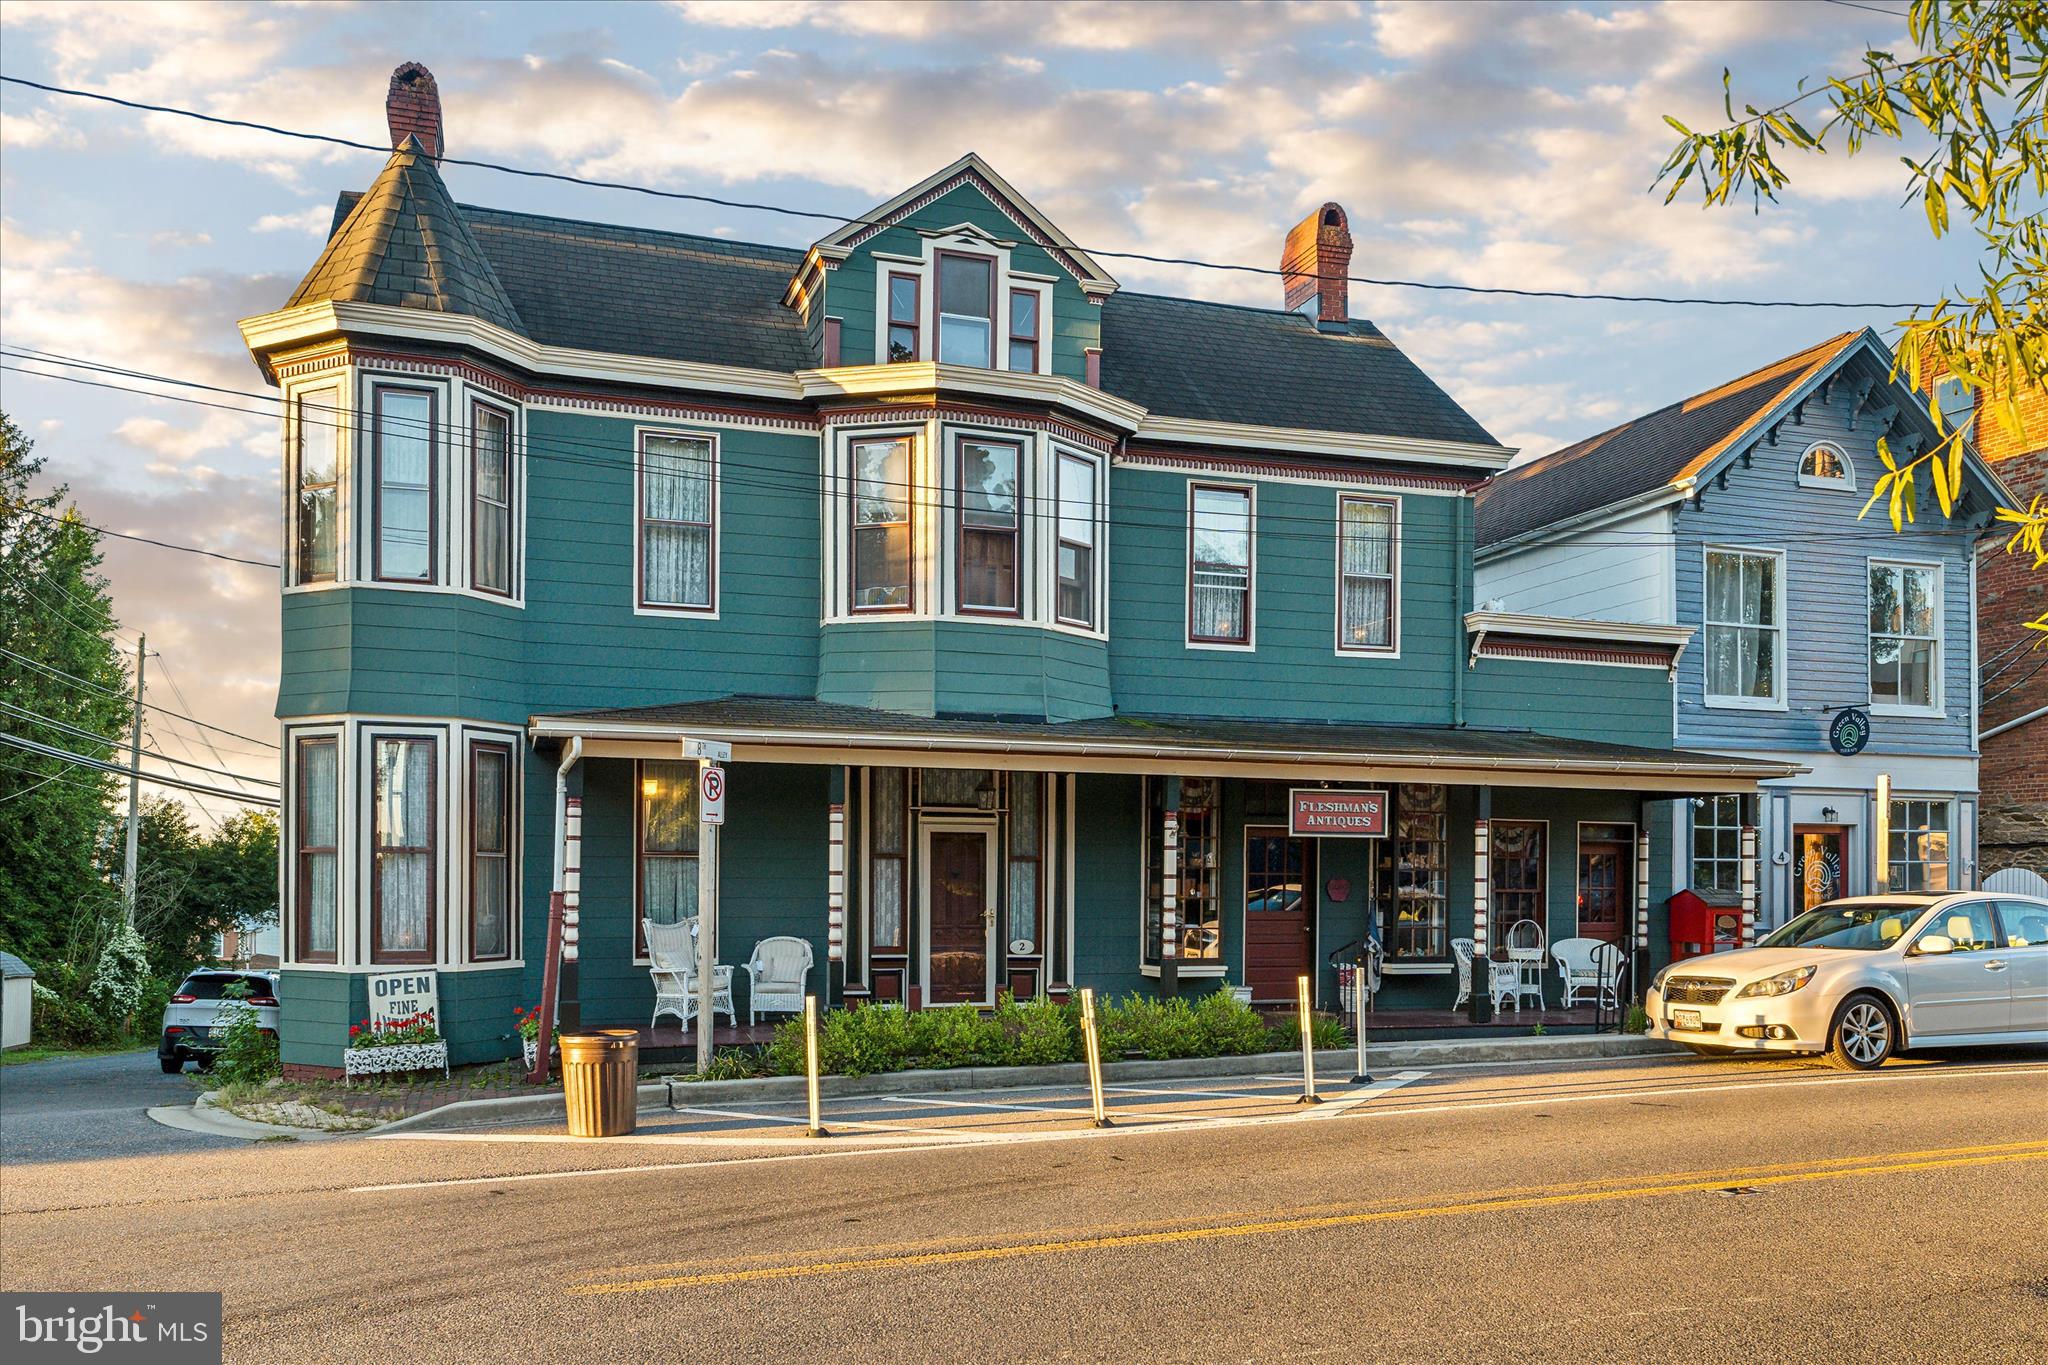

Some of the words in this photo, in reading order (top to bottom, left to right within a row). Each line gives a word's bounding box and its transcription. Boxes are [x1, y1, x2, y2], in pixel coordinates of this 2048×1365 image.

[1832, 716, 1850, 738] Green
[1851, 713, 1866, 736] Valley
[1299, 800, 1379, 814] FLESHMAN'S
[1306, 815, 1372, 828] ANTIQUES
[1778, 851, 1785, 862] 4
[1820, 845, 1841, 878] Valley
[1019, 942, 1026, 951] 2
[375, 976, 431, 997] OPEN
[389, 1000, 419, 1015] FINE
